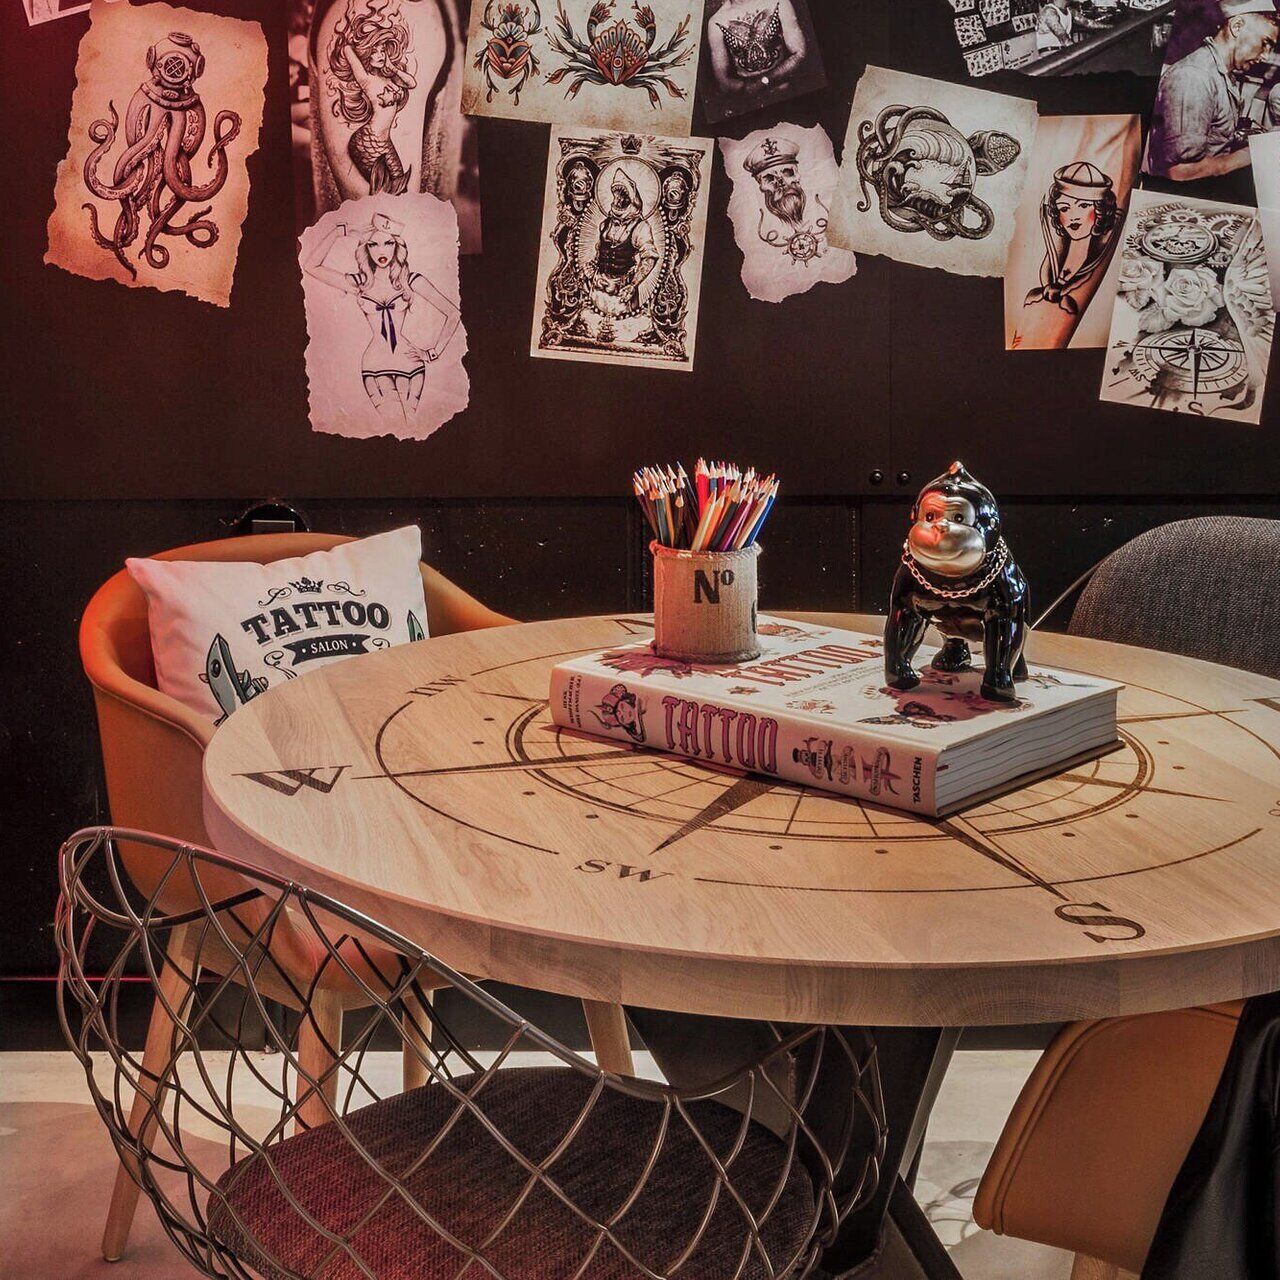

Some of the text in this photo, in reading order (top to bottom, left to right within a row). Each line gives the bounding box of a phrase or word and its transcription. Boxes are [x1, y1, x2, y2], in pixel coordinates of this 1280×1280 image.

[240, 600, 391, 645] TATTOO
[310, 639, 348, 654] SALON
[719, 644, 884, 687] TATTOO
[661, 695, 779, 775] TATTOO
[231, 765, 352, 796] W
[912, 757, 922, 804] TASCHEN
[1054, 901, 1146, 943] S
